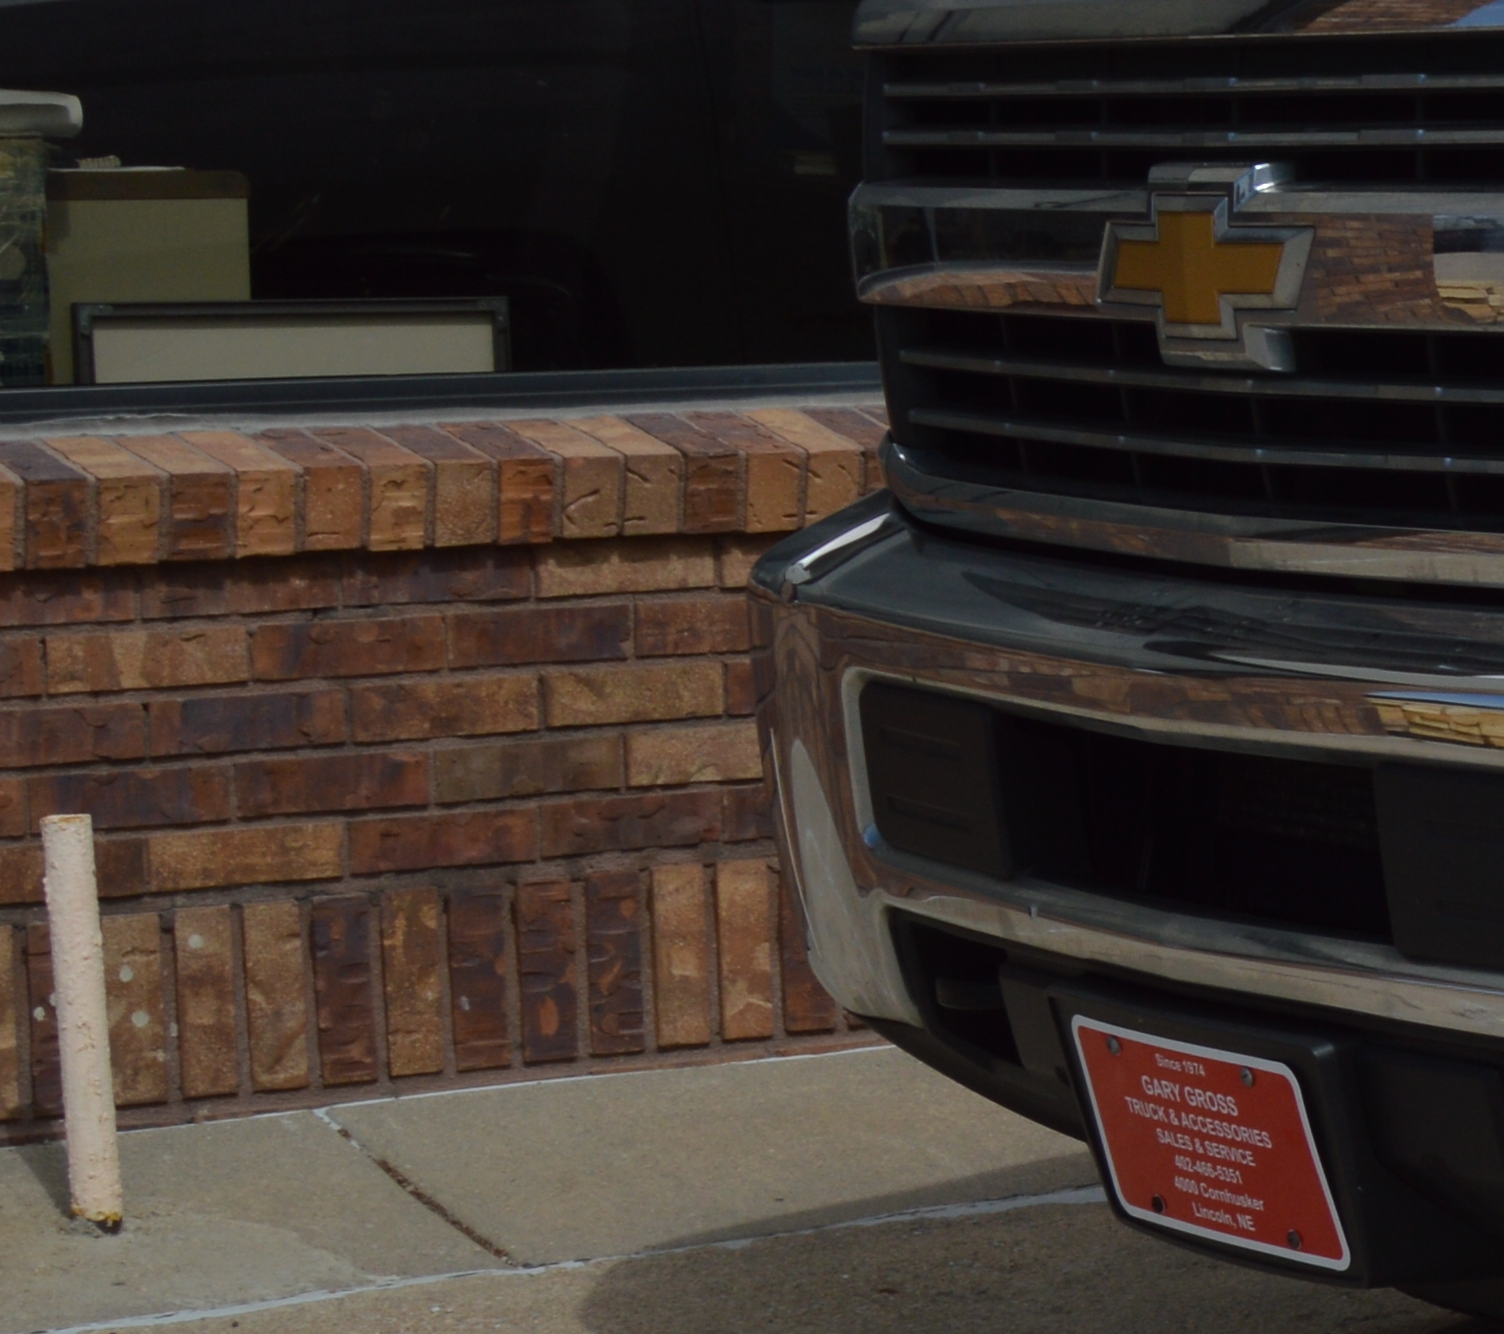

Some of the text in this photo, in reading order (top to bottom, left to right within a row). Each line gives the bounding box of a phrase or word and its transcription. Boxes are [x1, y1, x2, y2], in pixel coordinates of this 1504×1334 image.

[1155, 1053, 1205, 1077] Since 1974
[1141, 1075, 1239, 1116] GARY GROSS
[1124, 1096, 1273, 1149] TRUCK & ACCESSORIES
[1156, 1128, 1256, 1167] SALES & SERVICE
[1200, 1182, 1265, 1212] Cornhusker
[1237, 1213, 1256, 1232] NE
